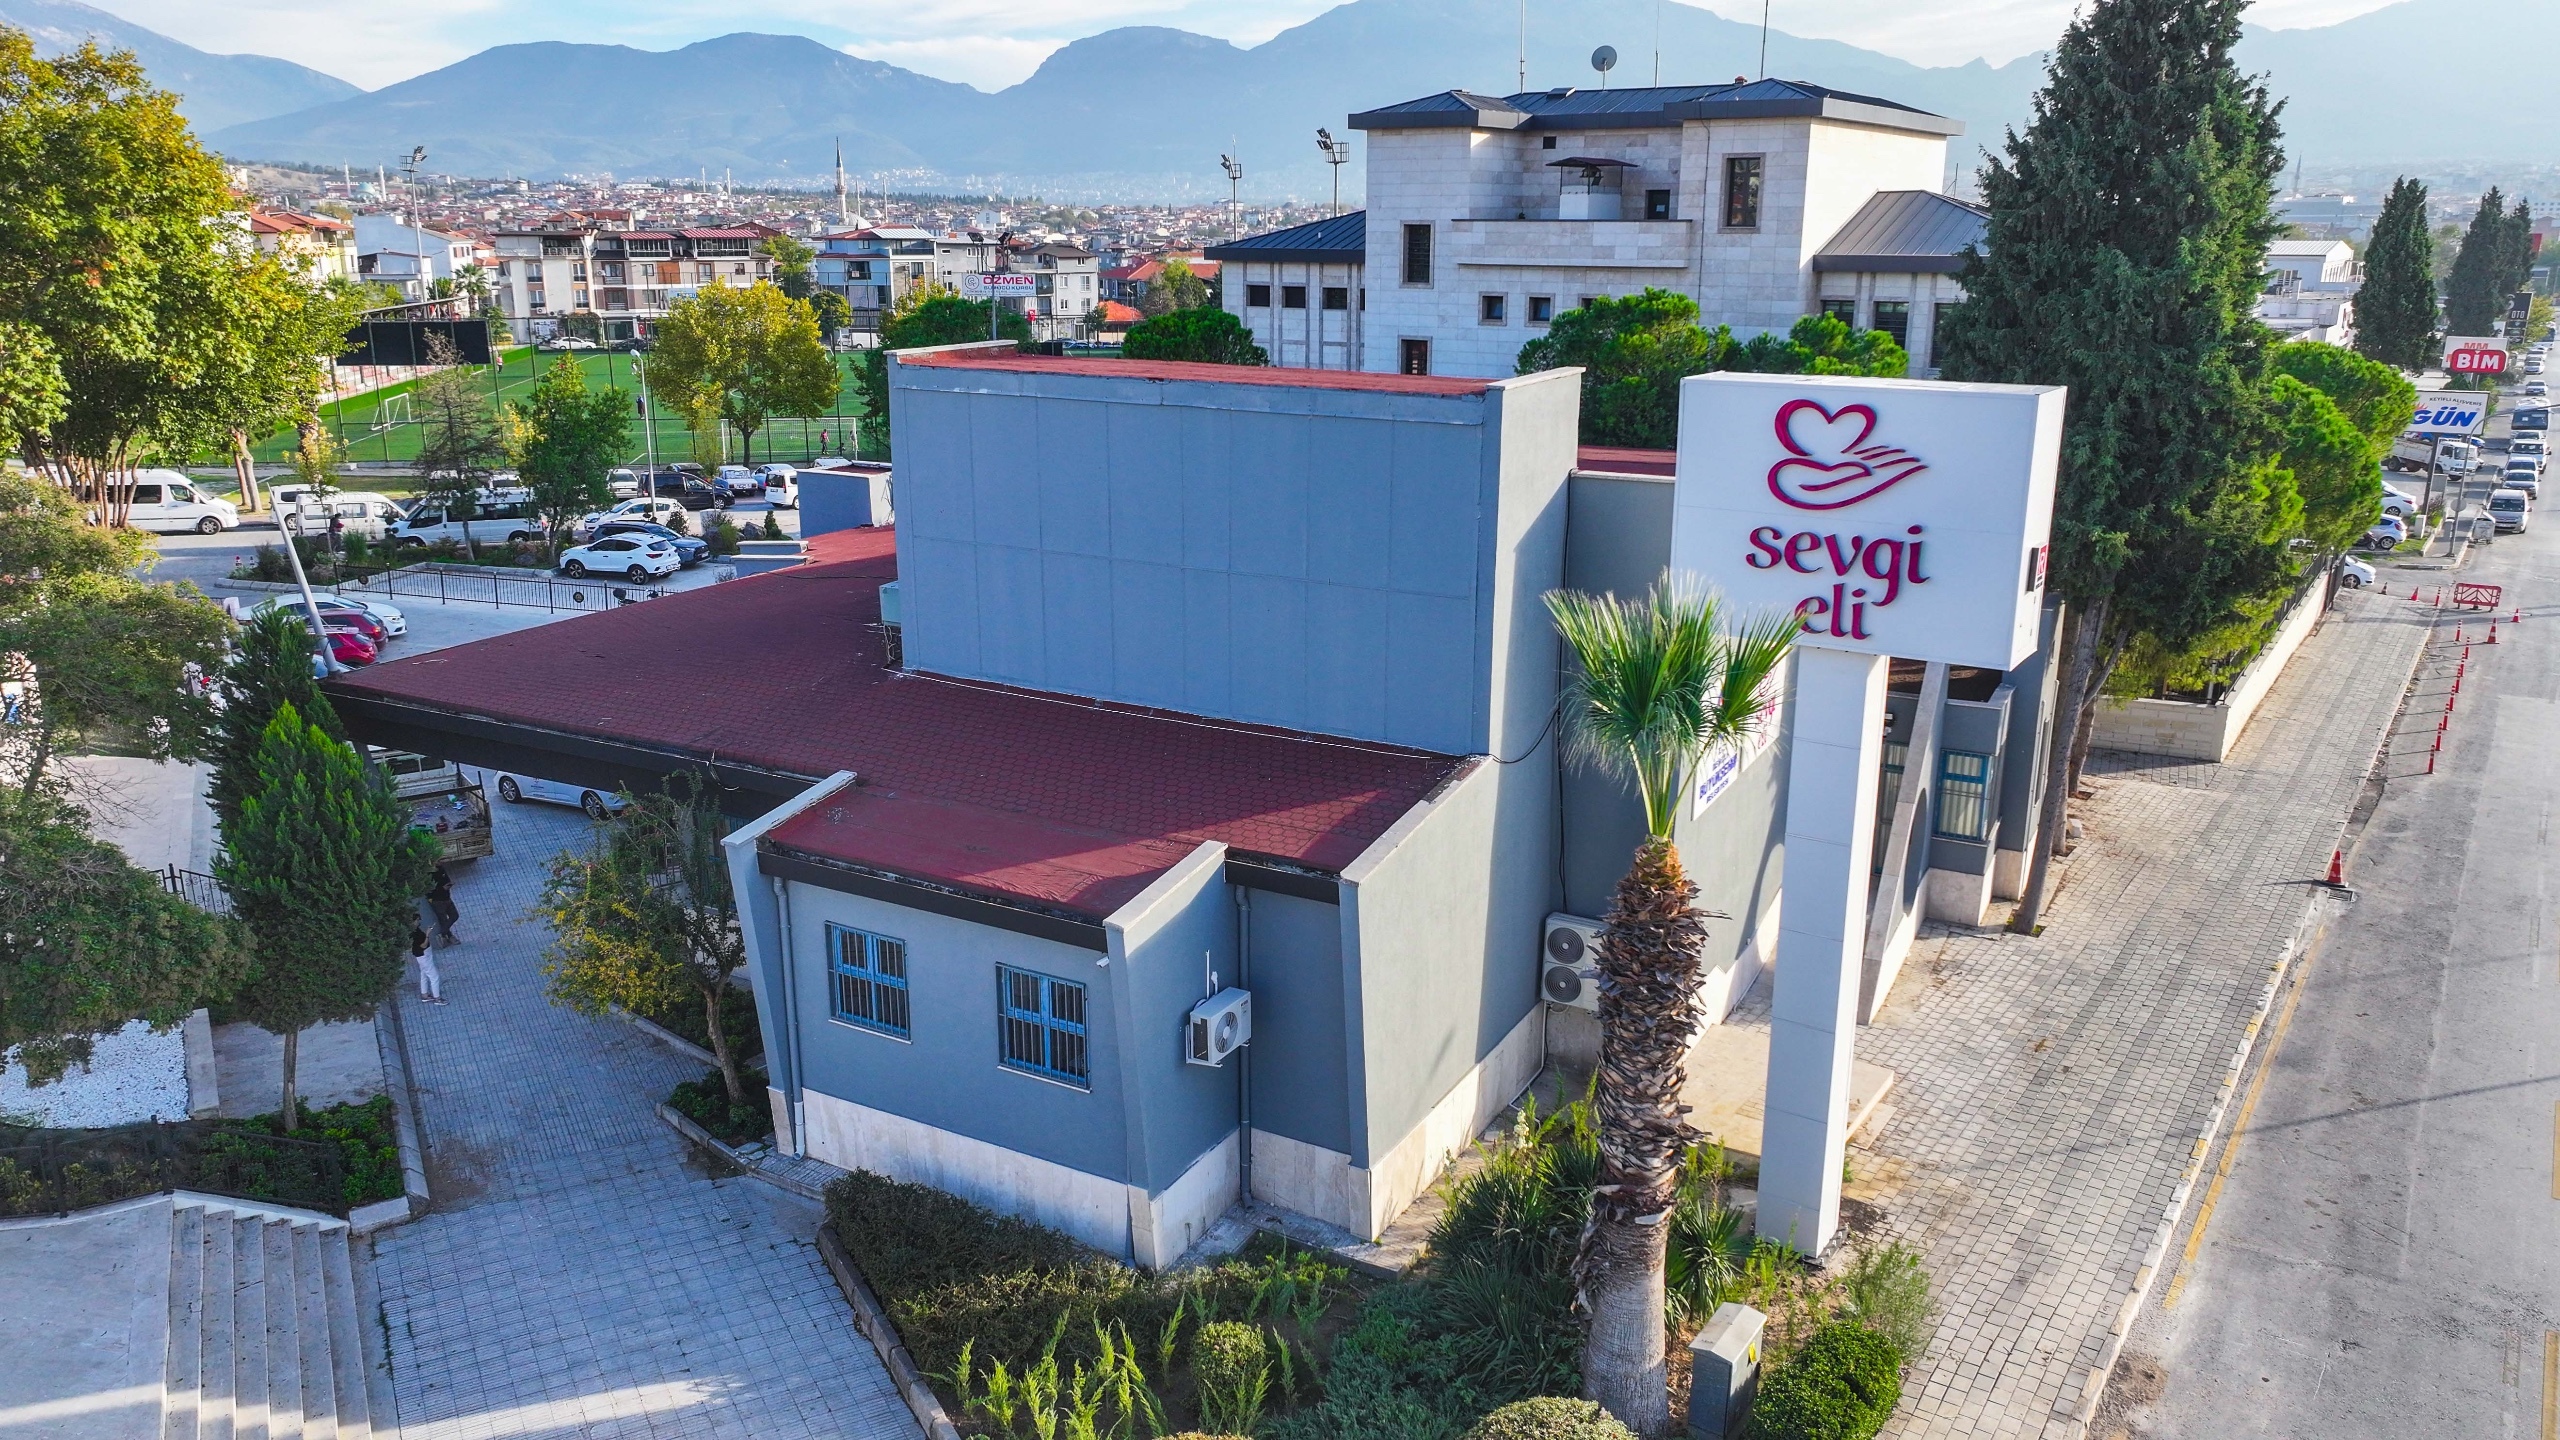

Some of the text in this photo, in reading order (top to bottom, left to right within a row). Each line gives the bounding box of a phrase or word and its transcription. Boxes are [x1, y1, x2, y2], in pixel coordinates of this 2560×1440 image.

[983, 275, 1034, 284] ÖZMEN
[2456, 350, 2500, 369] BİM
[2412, 406, 2478, 427] GÜN
[1745, 524, 1931, 607] sevgi
[1795, 583, 1872, 640] eli
